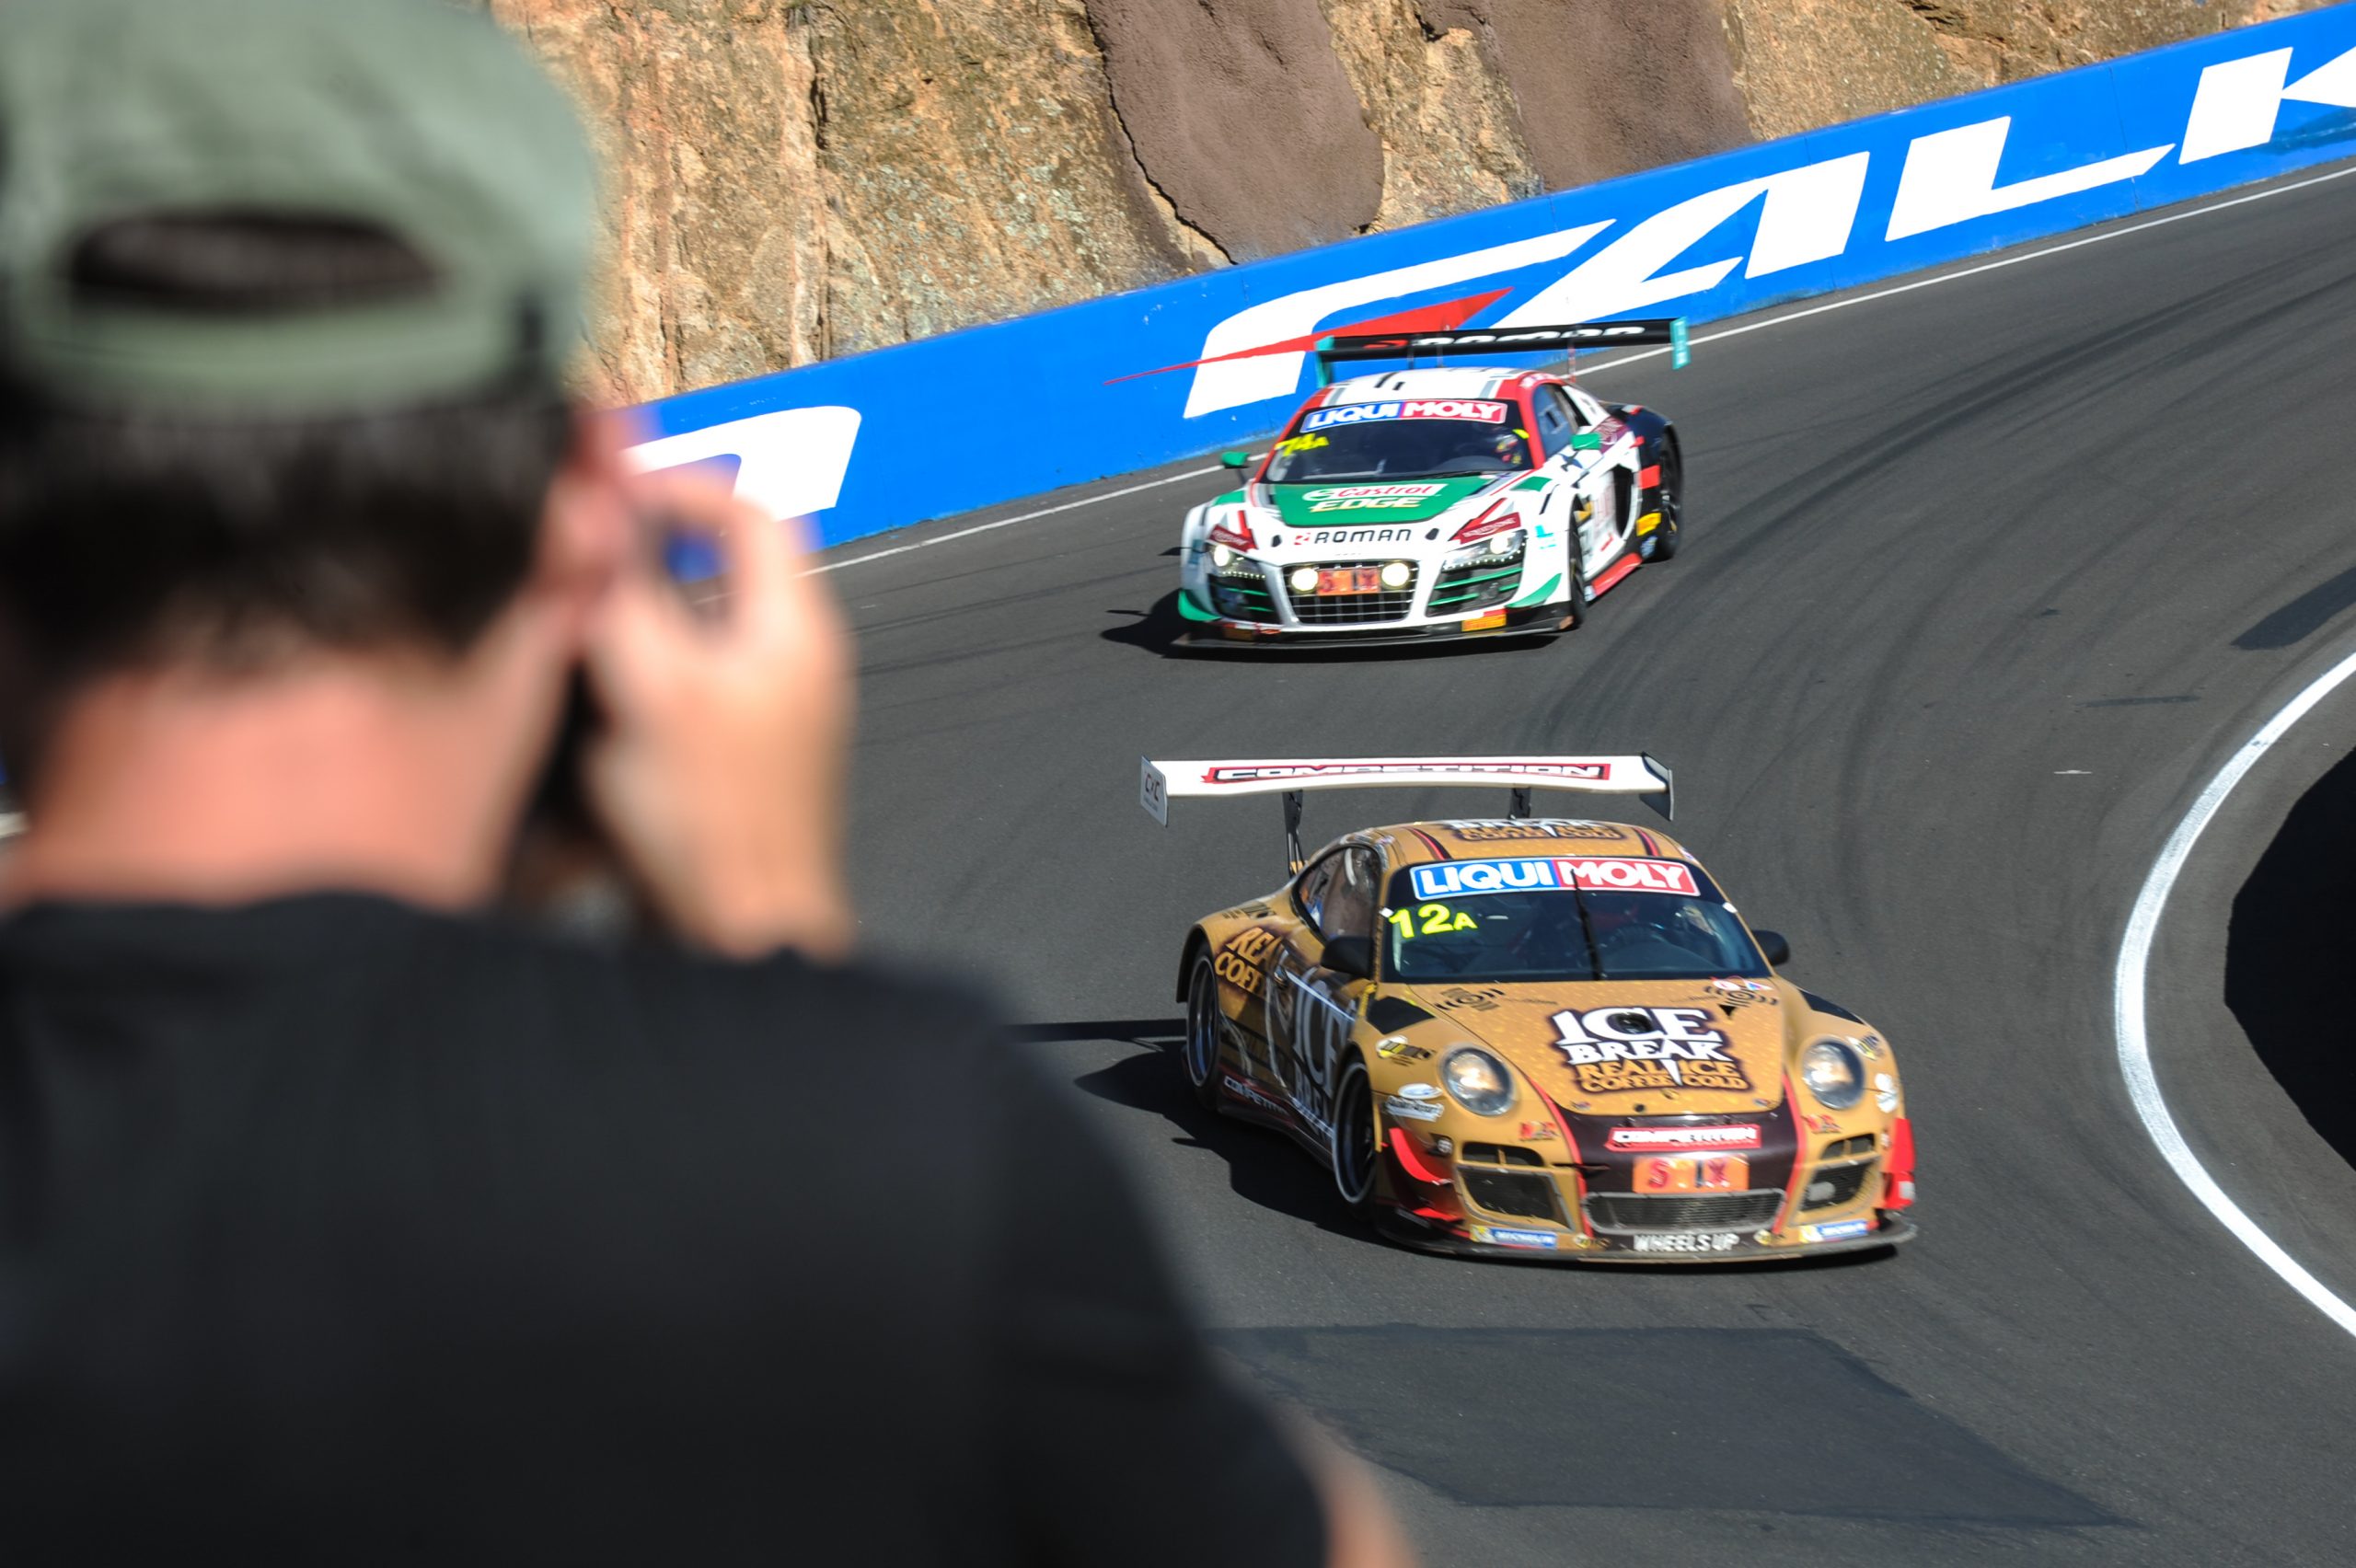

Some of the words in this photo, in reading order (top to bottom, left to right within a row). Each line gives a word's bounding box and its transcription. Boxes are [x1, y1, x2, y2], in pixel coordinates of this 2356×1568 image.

[1308, 403, 1402, 429] LIQUI
[1403, 402, 1503, 420] MOLY
[1338, 485, 1433, 498] Castrol
[1308, 497, 1427, 513] EDGE
[1314, 528, 1412, 544] ROMAN
[1420, 861, 1555, 894] LIQUI
[1557, 860, 1685, 889] MOLY
[1389, 904, 1478, 939] 12A
[1552, 1007, 1723, 1045] ICE
[1559, 1039, 1734, 1066] BREAK
[1575, 1059, 1670, 1080] REAL
[1677, 1059, 1741, 1078] ICE
[1580, 1075, 1675, 1092] COFFEE
[1680, 1074, 1749, 1090] COLD
[1634, 1234, 1711, 1251] WHEELS
[1713, 1233, 1740, 1251] UP
